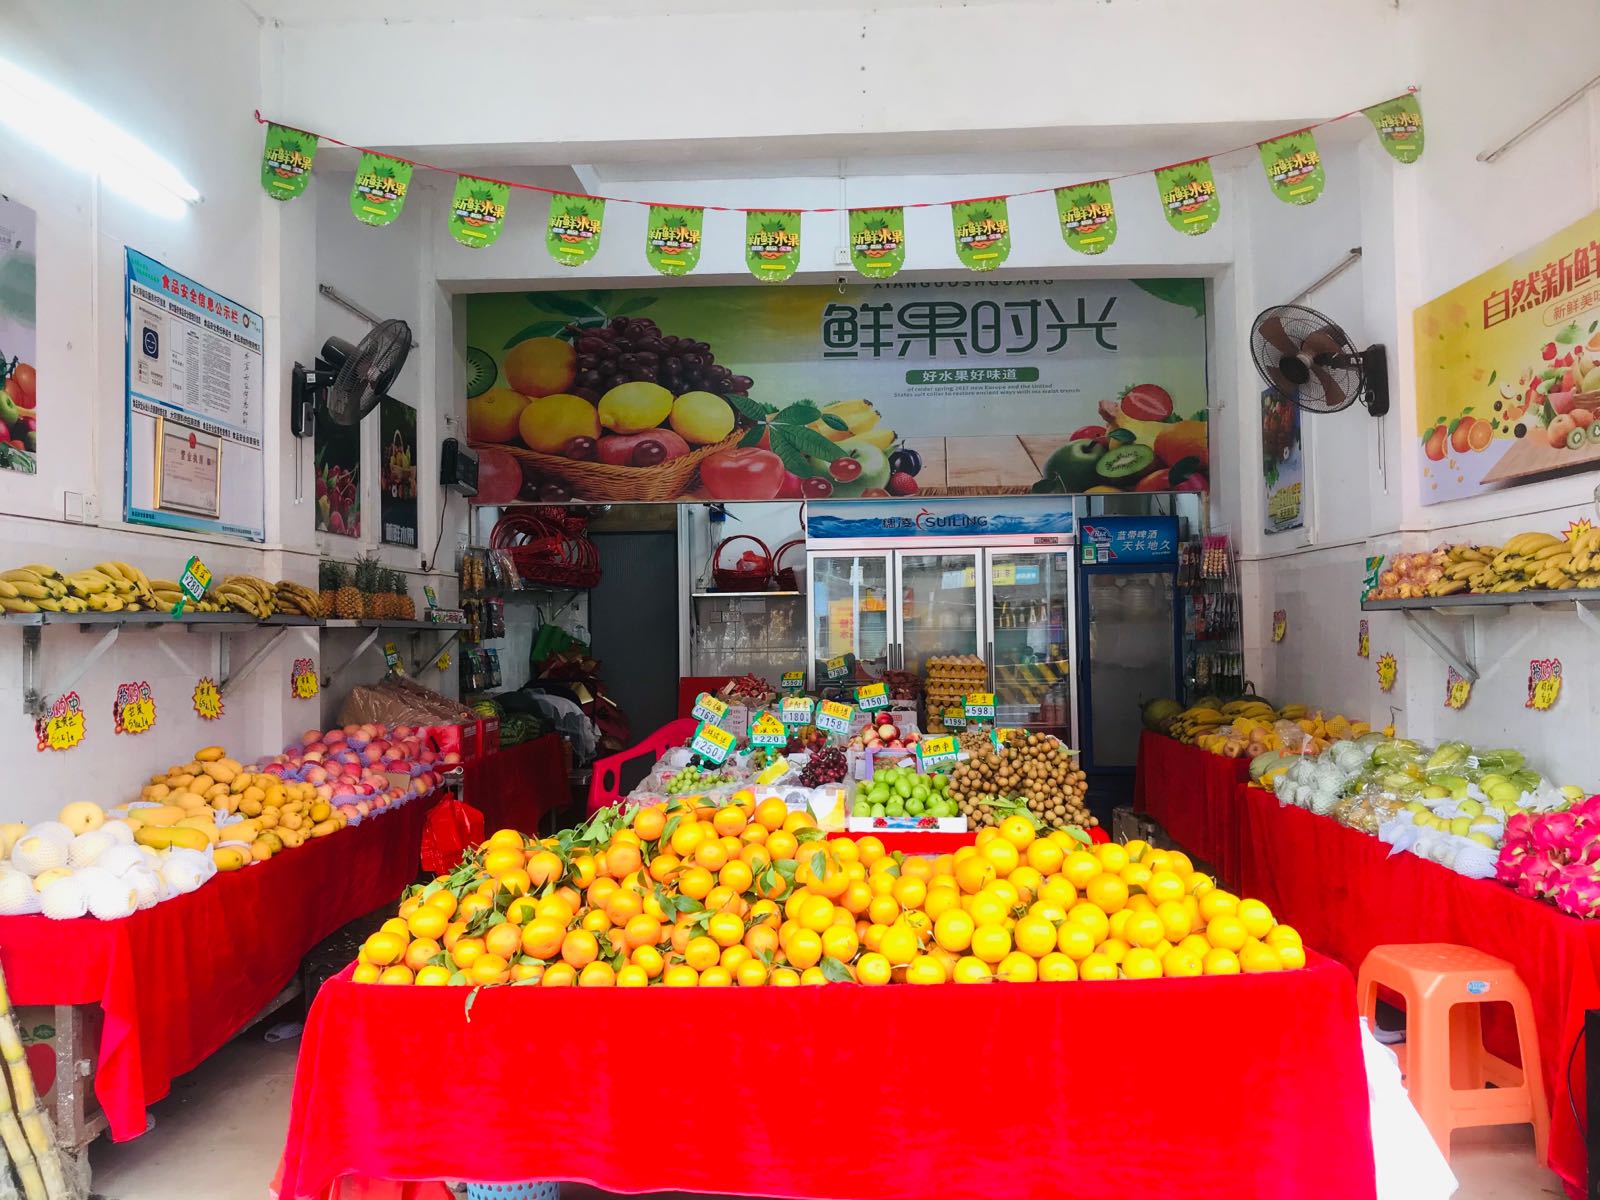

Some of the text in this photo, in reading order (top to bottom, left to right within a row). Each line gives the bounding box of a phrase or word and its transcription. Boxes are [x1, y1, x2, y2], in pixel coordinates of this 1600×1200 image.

[1376, 110, 1421, 128] 新鲜水果
[265, 148, 312, 170] 新鲜水果
[1268, 150, 1320, 175] 新鲜水果
[356, 174, 406, 196] 新鲜水果
[1162, 181, 1216, 203] 新鲜水果
[454, 199, 505, 218] 新鲜水果
[1062, 203, 1114, 223] 新鲜水果
[552, 214, 601, 233] 新鲜水果
[956, 219, 1009, 240] 新鲜水果
[649, 226, 701, 243] 新鲜水果
[750, 231, 800, 247] 新鲜水果
[852, 229, 904, 245] 新鲜水果
[162, 274, 239, 324] 食品安全信息公示栏
[824, 297, 1118, 357] 鲜果时光
[922, 368, 1017, 382] 好水果好味道
[925, 516, 988, 529] SUILING
[1117, 529, 1158, 541] 蓝带啤酒
[1121, 540, 1171, 551] 天长地久
